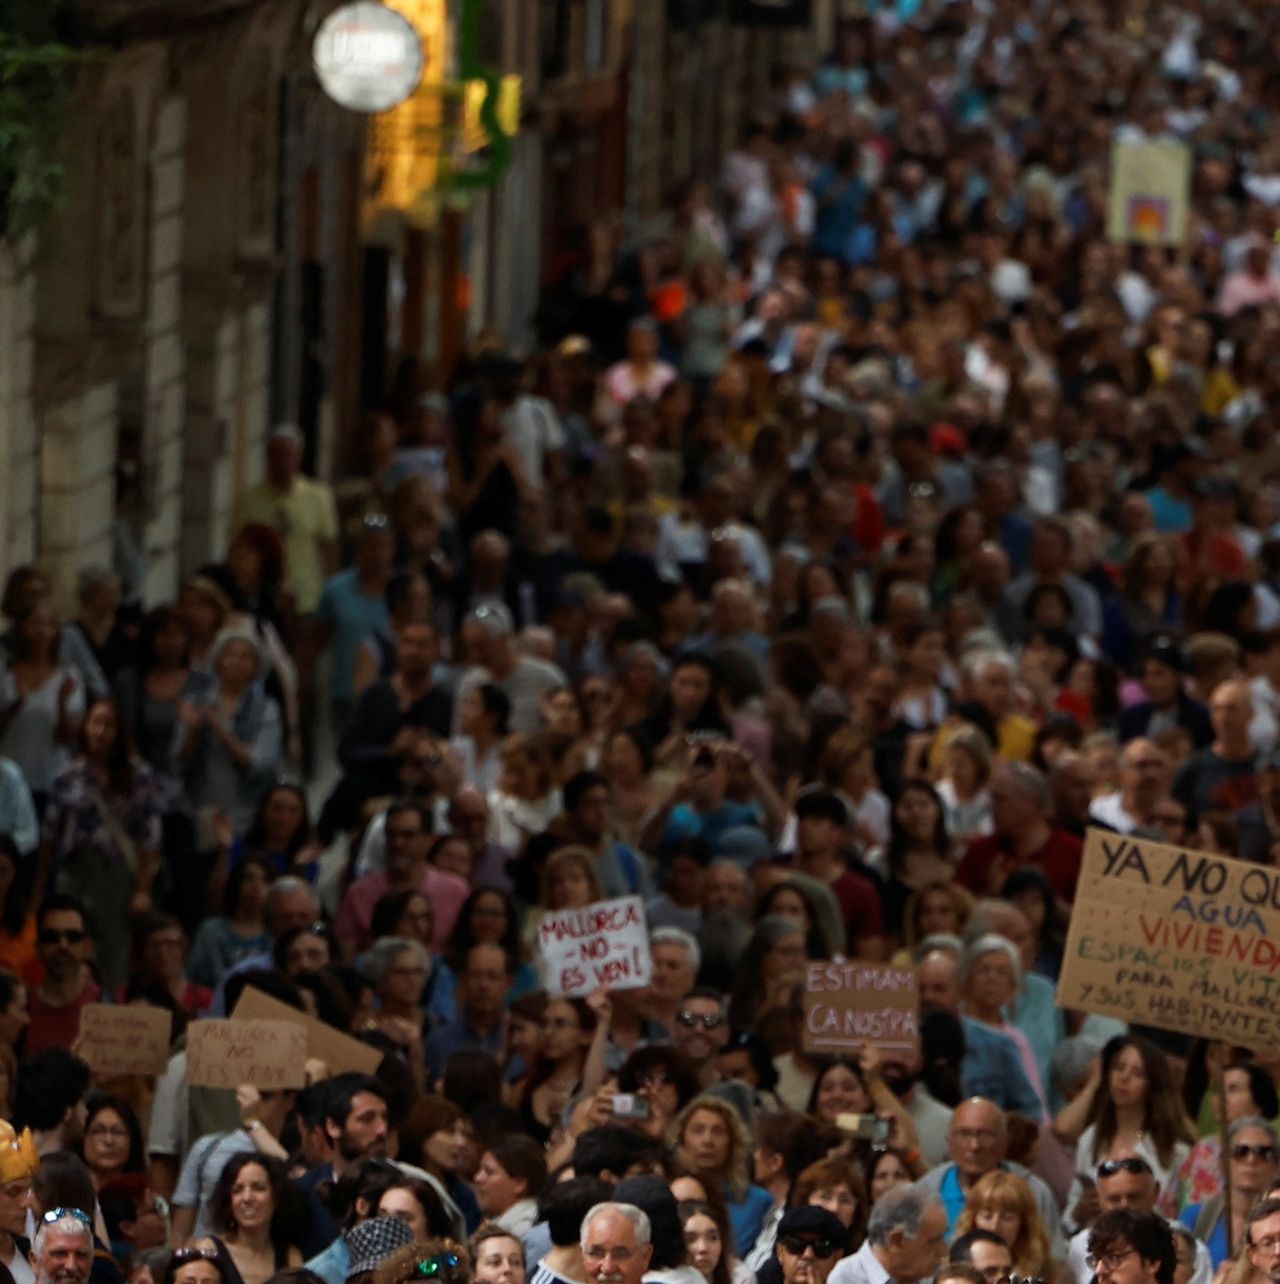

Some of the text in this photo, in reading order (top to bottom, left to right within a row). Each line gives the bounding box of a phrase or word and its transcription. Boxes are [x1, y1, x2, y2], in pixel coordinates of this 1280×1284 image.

[1101, 838, 1151, 884] YA
[1163, 853, 1228, 896] NO
[542, 904, 639, 943] MALLORCA
[1172, 895, 1267, 935] AGUA
[1115, 967, 1175, 990] PARA
